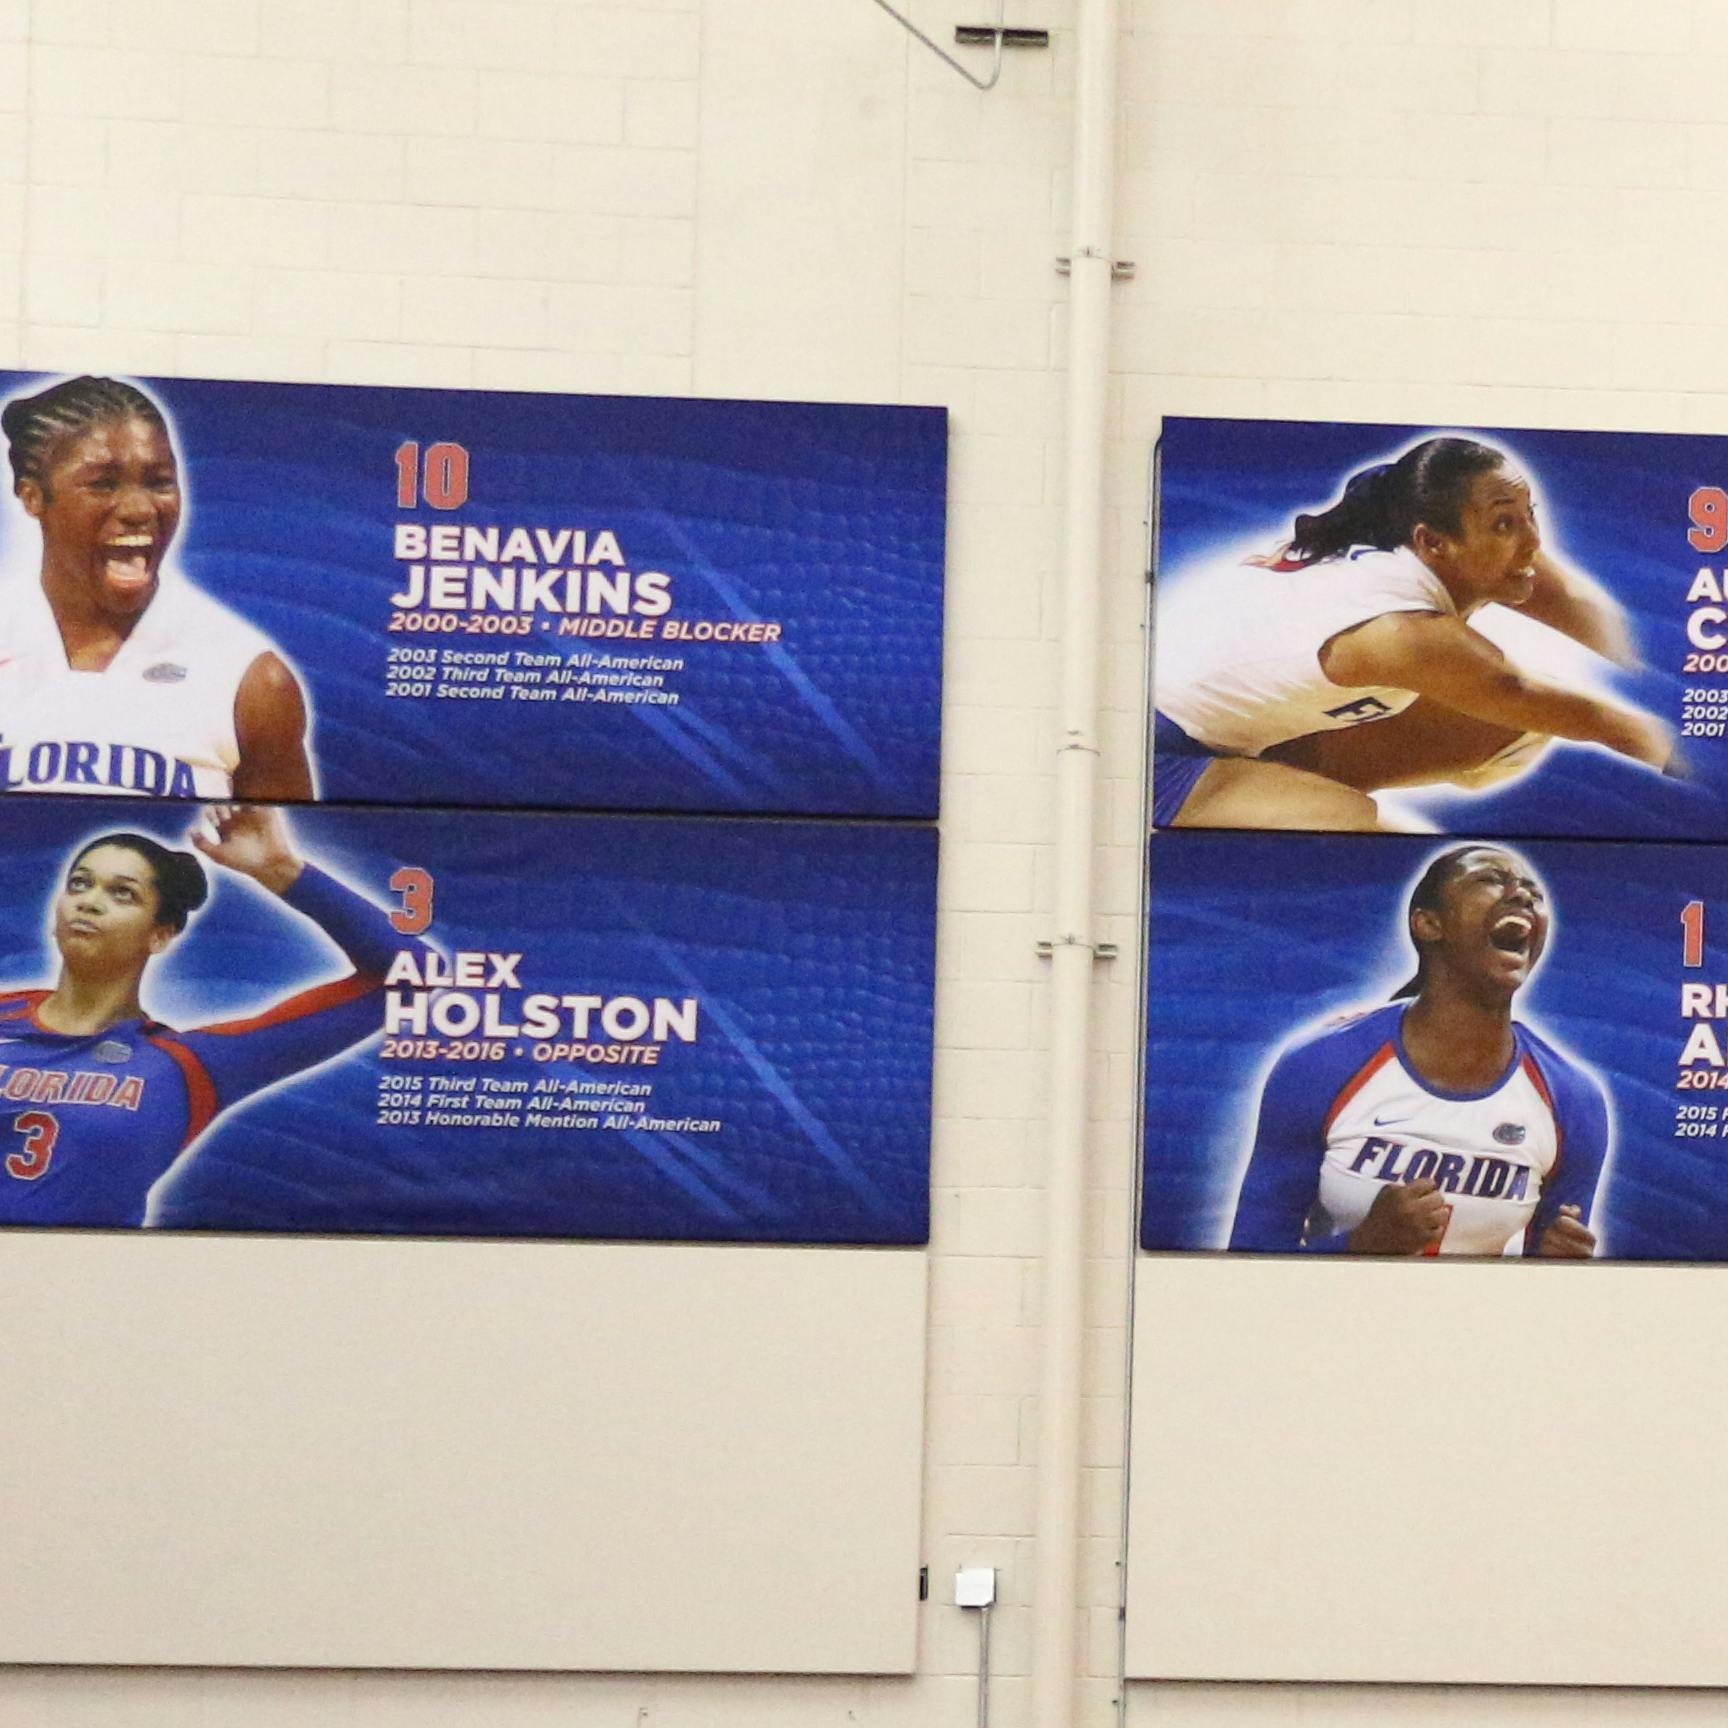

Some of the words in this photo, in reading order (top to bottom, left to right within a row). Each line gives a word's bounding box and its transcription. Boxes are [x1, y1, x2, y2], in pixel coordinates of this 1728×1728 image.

[394, 441, 470, 510] 10
[394, 524, 625, 566] BENAVIA
[389, 565, 672, 616] JENKINS
[388, 613, 533, 634] 2000-2003
[557, 619, 656, 639] MIDDLE
[662, 622, 781, 642] BLOCKER
[387, 649, 437, 663] 2003
[442, 650, 509, 666] Second
[515, 652, 561, 667] Team
[567, 654, 683, 670] All-American
[386, 666, 434, 680] 2002
[443, 667, 489, 681] Third
[495, 669, 541, 683] Team
[546, 671, 663, 687] All-American
[386, 683, 431, 696] 2001
[437, 684, 504, 700] Second
[510, 687, 555, 701] Team
[561, 688, 678, 705] All-American
[1682, 689, 1728, 702] 2003
[1682, 706, 1728, 720] 2002
[1681, 722, 1725, 736] 2001
[0, 741, 196, 797] LORIDA
[389, 867, 434, 935] 3
[1680, 900, 1704, 968] 1
[384, 951, 522, 988] ALEX
[385, 991, 698, 1042] HOLSTON
[379, 1041, 506, 1060] 2013-2016
[532, 1044, 661, 1064] OPPOSITE
[0, 1064, 144, 1111] ORIDA
[379, 1077, 423, 1090] 2015
[429, 1077, 476, 1091] Third
[482, 1079, 528, 1092] Team
[533, 1080, 652, 1096] All-American
[378, 1095, 420, 1108] 2014
[428, 1095, 470, 1109] First
[476, 1096, 522, 1110] Team
[527, 1097, 645, 1112] All-American
[1676, 1107, 1718, 1120] 2015
[377, 1112, 420, 1125] 2013
[425, 1112, 519, 1128] Honorable
[524, 1114, 598, 1129] Mention
[603, 1116, 720, 1132] All-American
[1675, 1124, 1717, 1137] 2014
[5, 1110, 60, 1181] 3
[1348, 1136, 1531, 1201] FLORIDA
